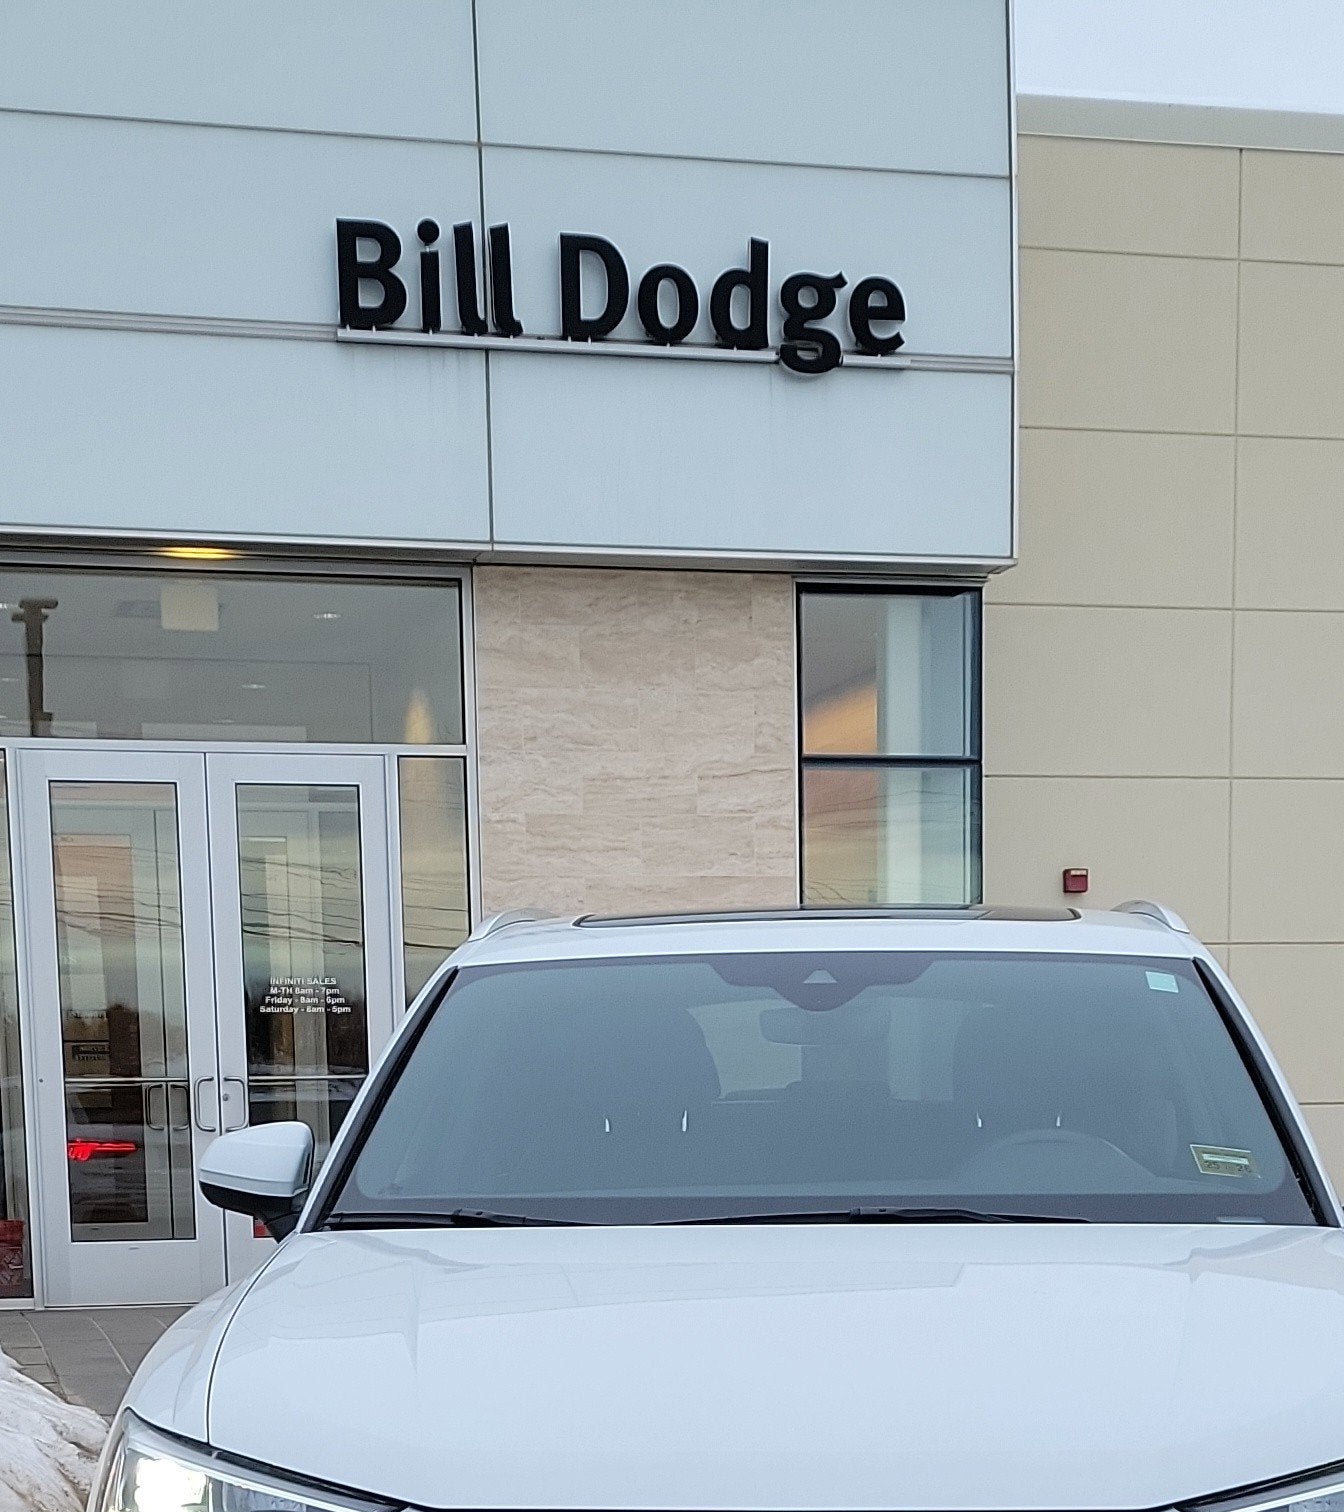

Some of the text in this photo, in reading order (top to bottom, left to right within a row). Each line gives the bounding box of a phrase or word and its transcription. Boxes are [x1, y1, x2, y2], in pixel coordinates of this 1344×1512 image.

[335, 216, 907, 375] Bill Dodge
[270, 977, 337, 985] INFINITI SALES
[265, 996, 293, 1005] Friday
[259, 1005, 299, 1014] Saturday
